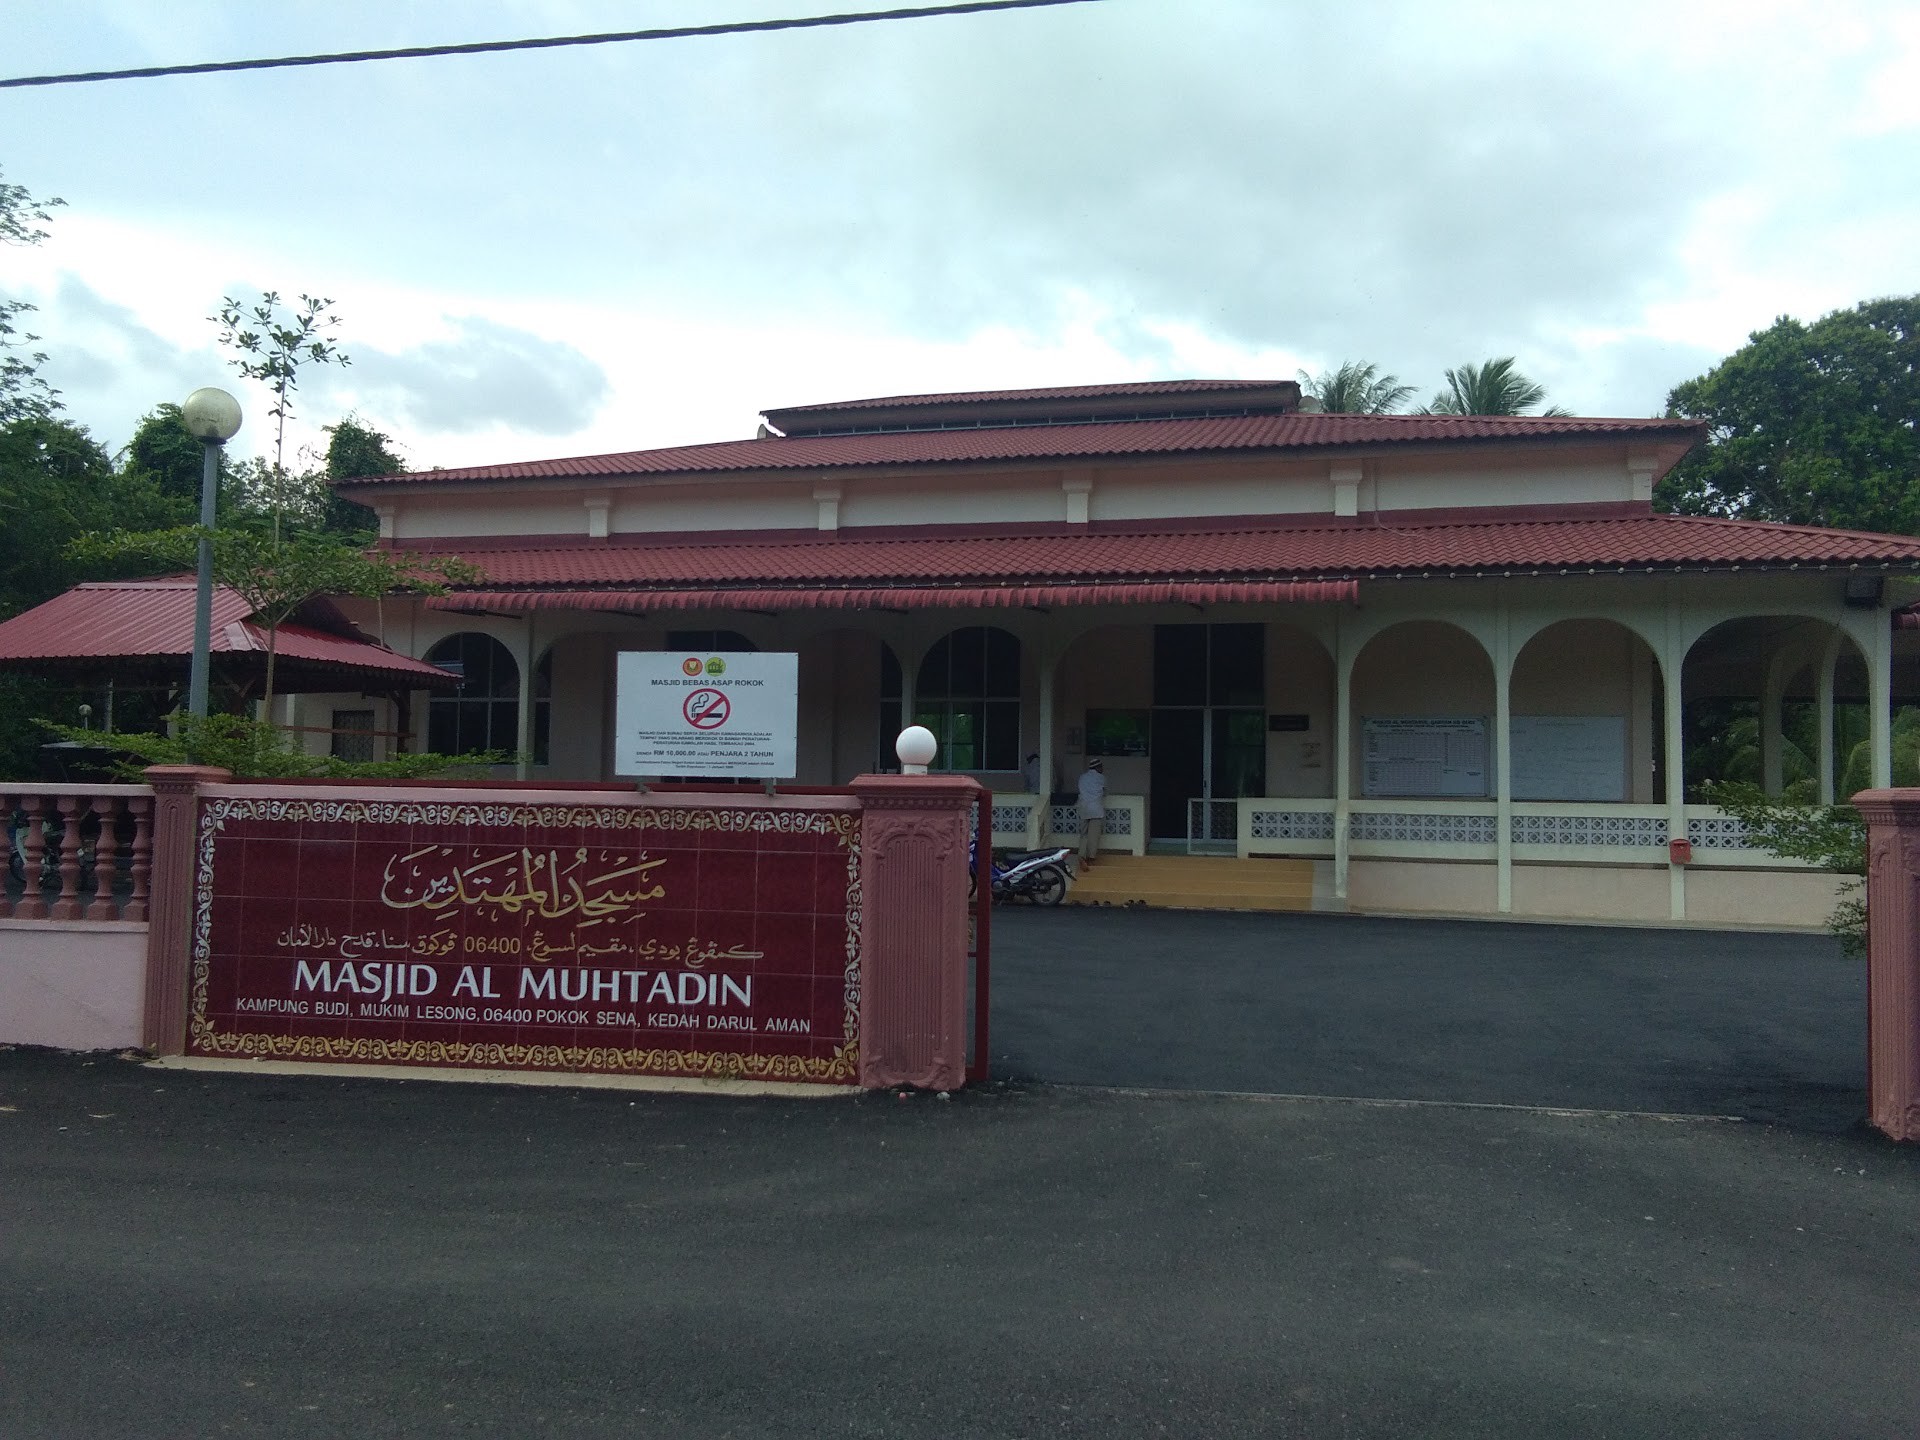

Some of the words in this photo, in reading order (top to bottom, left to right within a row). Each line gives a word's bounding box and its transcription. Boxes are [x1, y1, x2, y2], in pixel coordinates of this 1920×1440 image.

[464, 936, 521, 954] 06400
[294, 960, 438, 1002] MASJID
[452, 965, 501, 999] AL
[519, 967, 753, 1007] MUHTADIN
[236, 997, 309, 1015] KAMPUNG
[315, 1002, 354, 1018] BUDI,
[360, 1003, 410, 1018] MUKIM
[416, 1005, 481, 1022] LESONG,
[483, 1007, 532, 1023] 06400
[537, 1009, 589, 1025] POKOK
[597, 1011, 641, 1028] SENA,
[648, 1012, 700, 1029] KEDAH
[707, 1014, 758, 1031] DARUL
[765, 1017, 811, 1034] AMAN
